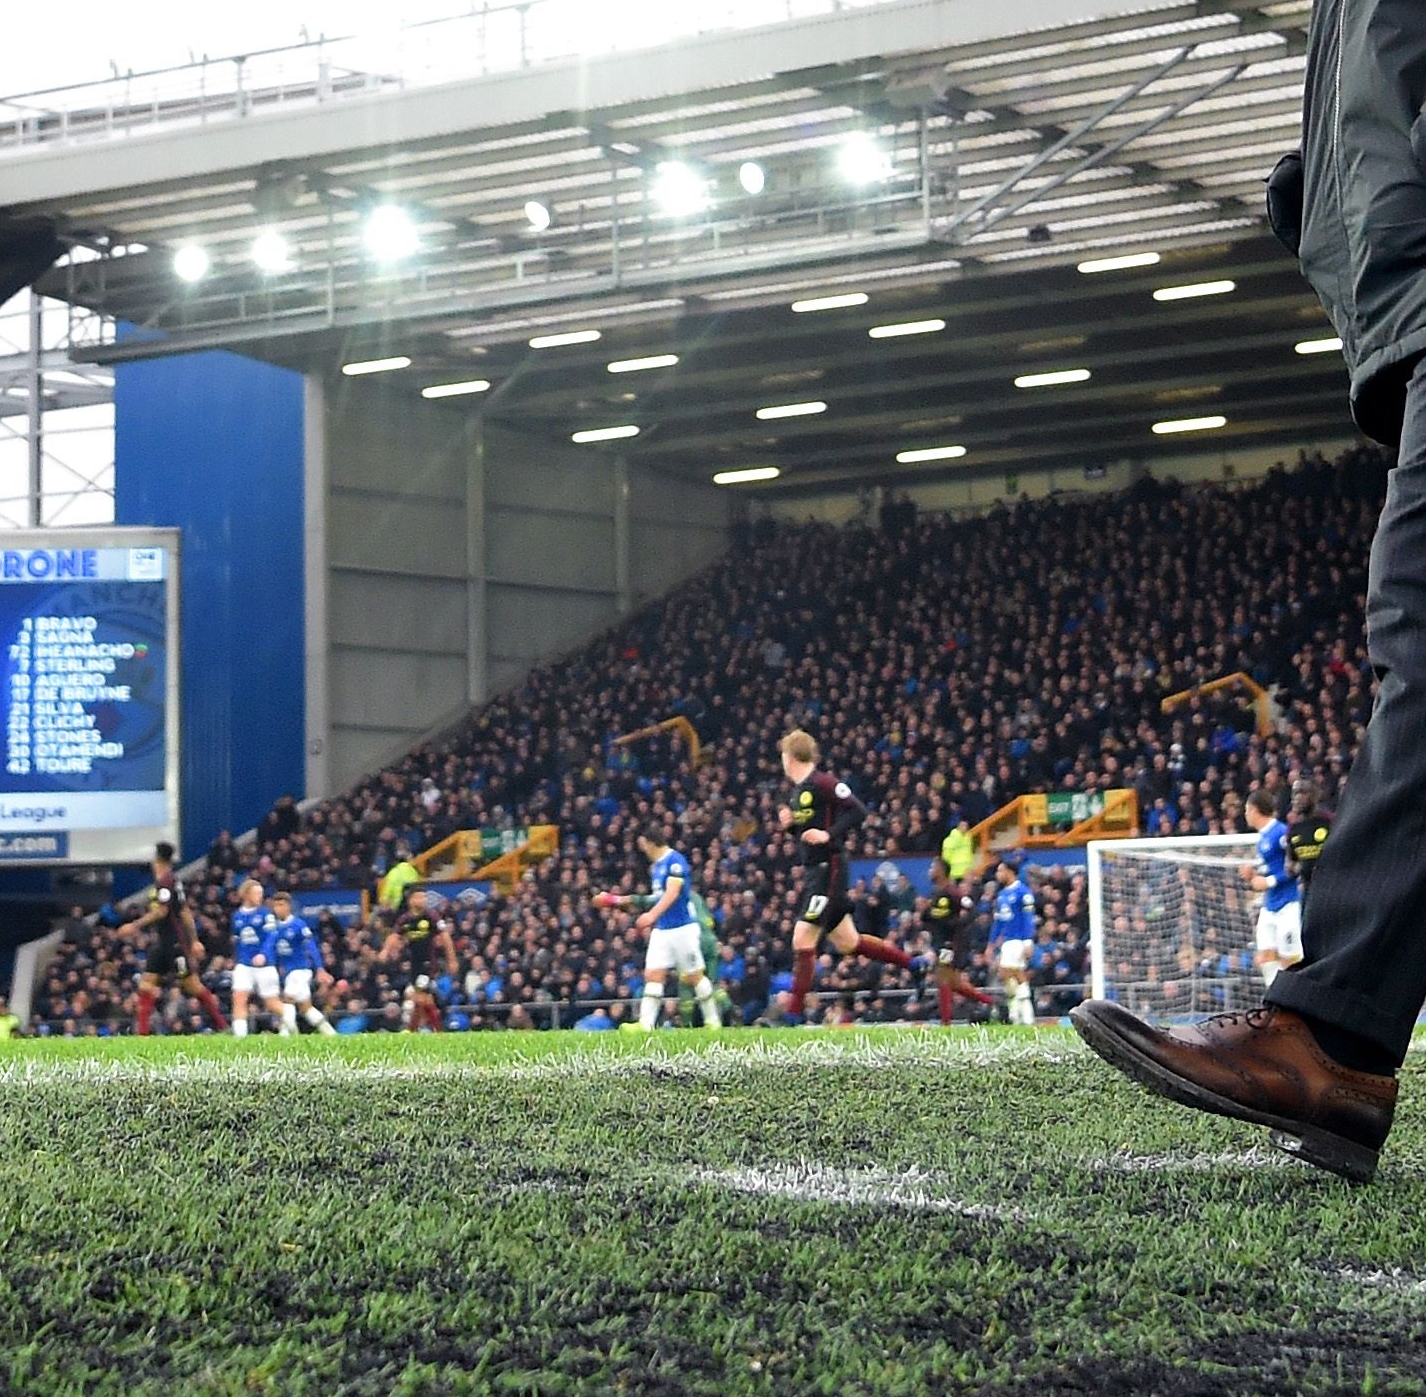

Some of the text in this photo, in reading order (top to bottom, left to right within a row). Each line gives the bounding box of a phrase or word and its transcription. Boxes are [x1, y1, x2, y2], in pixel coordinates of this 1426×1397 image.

[34, 616, 97, 631] BRAVO
[34, 657, 116, 673] STERLING
[33, 701, 84, 715] SILVA
[33, 728, 102, 743] STONES
[35, 757, 92, 774] TOURE
[0, 802, 68, 822] League
[808, 894, 830, 916] 17
